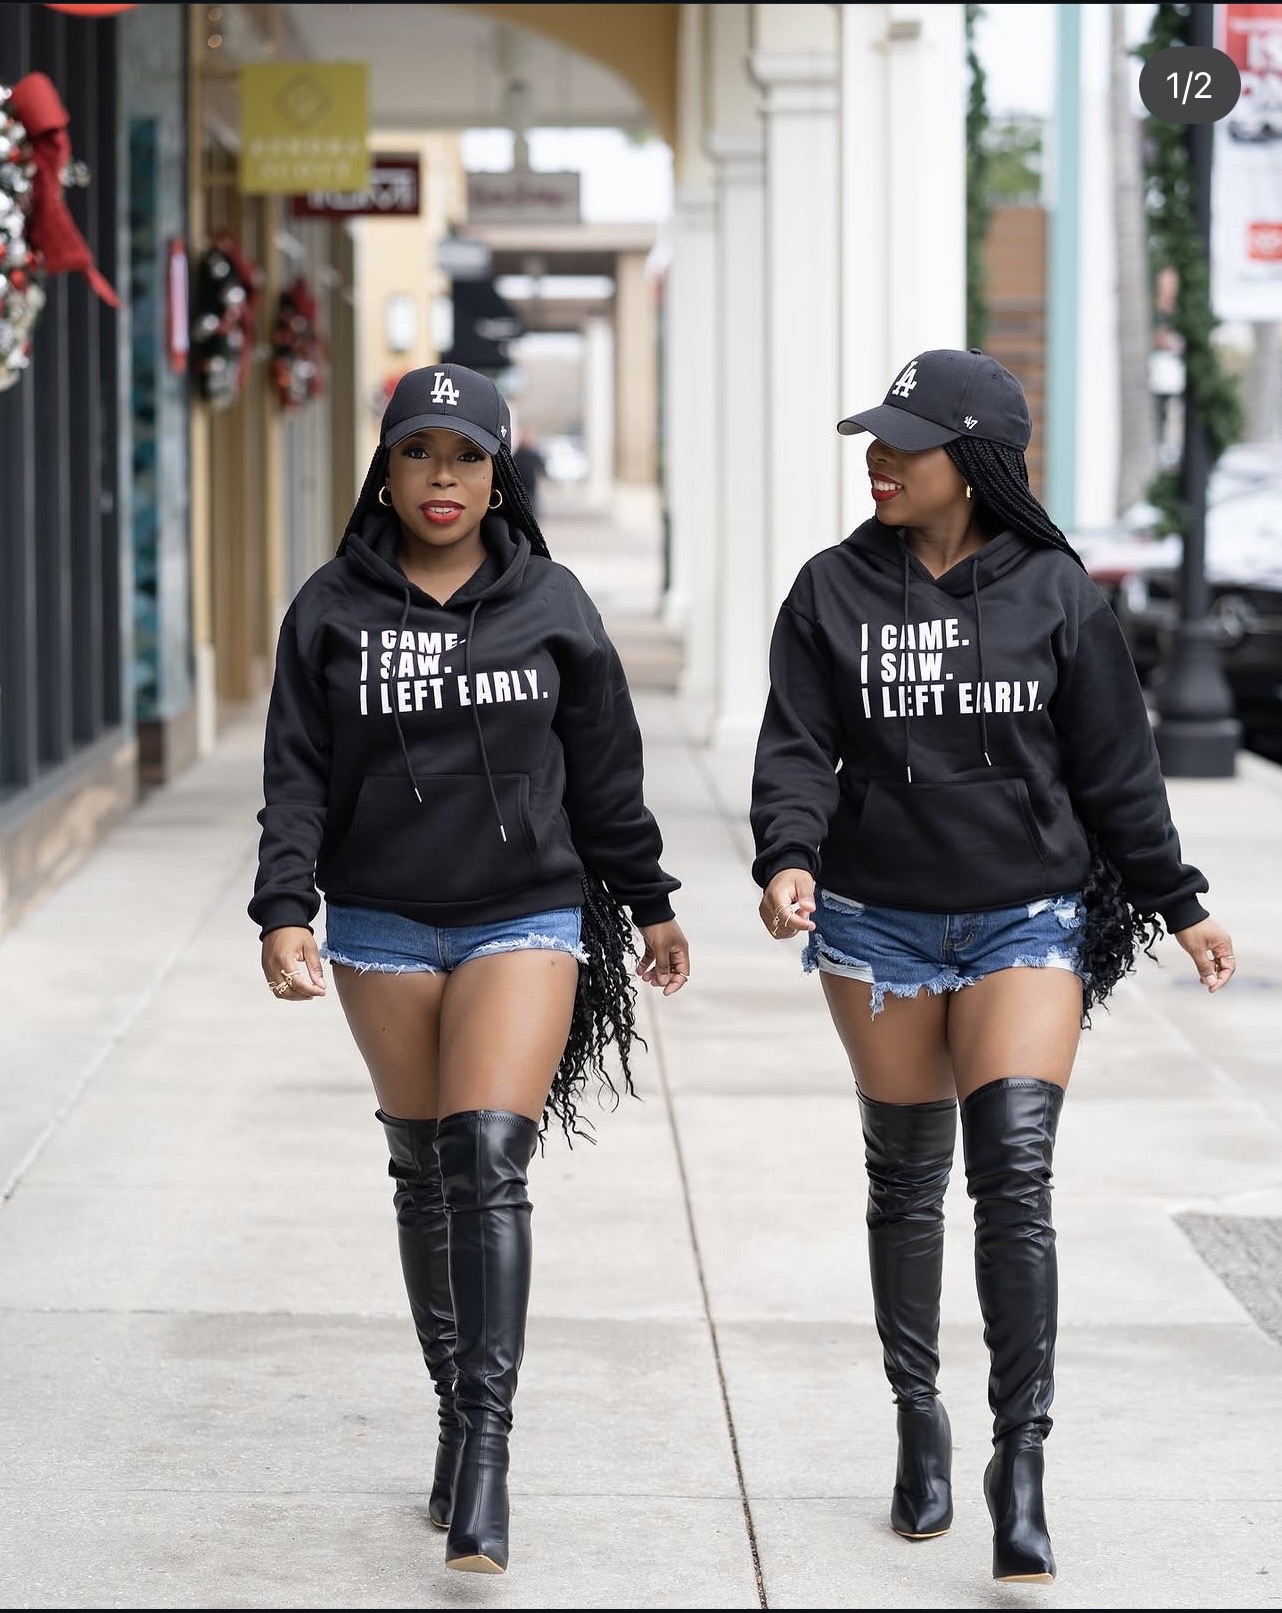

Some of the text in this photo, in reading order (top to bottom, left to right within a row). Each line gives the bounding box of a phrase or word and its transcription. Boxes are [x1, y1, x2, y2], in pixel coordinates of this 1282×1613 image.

[430, 372, 460, 406] LA
[892, 361, 918, 398] LA
[360, 630, 369, 647] I
[861, 618, 970, 652] I CAME.
[360, 651, 452, 681] I SAW.
[860, 652, 954, 684] I SAW.
[360, 669, 549, 715] I LEFT EARLY.
[861, 680, 1043, 719] I LEFT EARLY.
